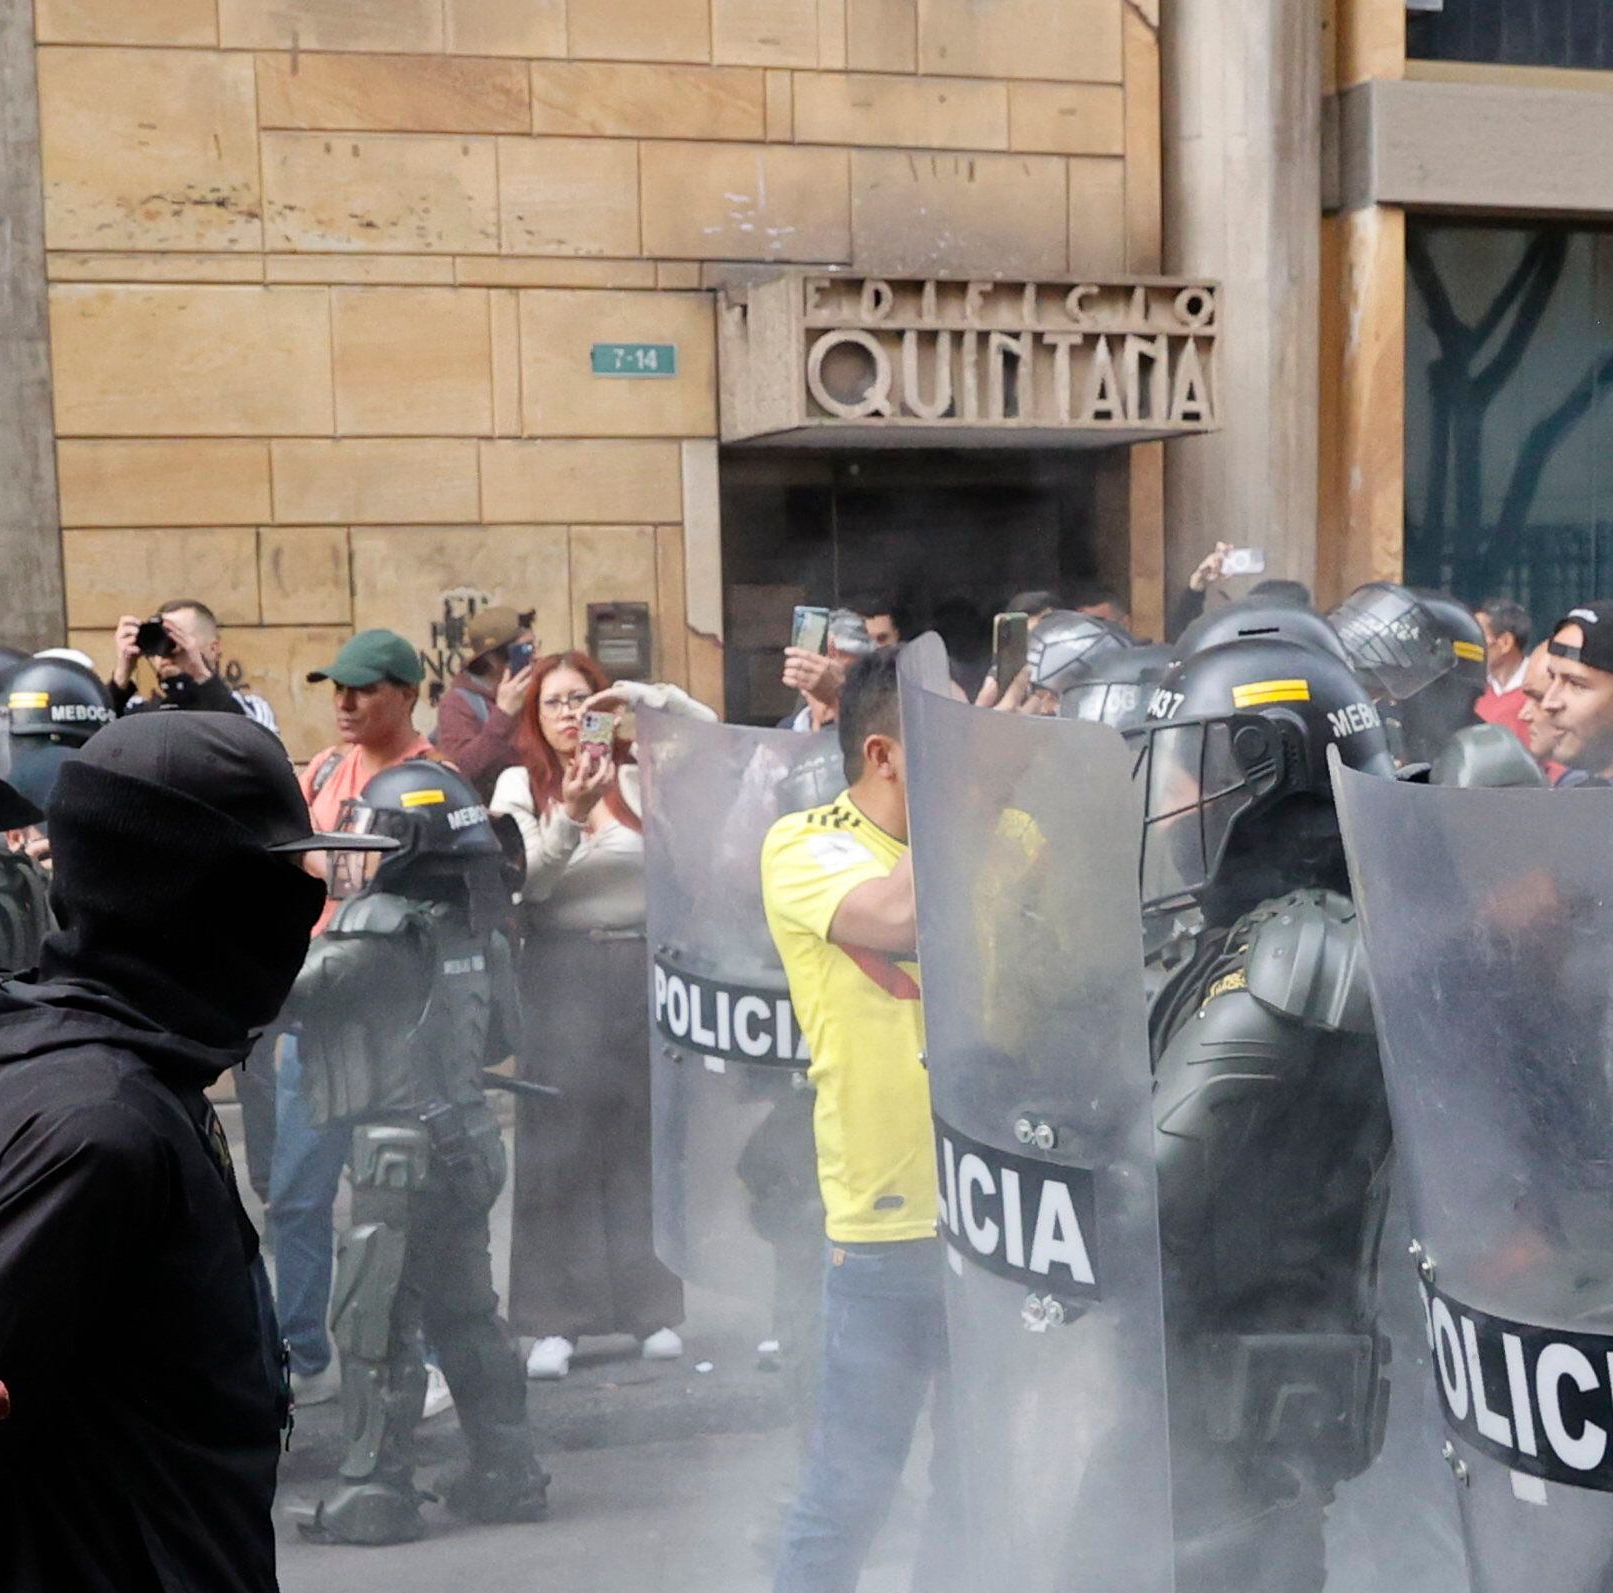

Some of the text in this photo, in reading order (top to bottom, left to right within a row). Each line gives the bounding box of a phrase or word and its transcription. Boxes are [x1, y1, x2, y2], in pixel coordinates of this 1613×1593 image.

[805, 278, 1216, 328] EDIFICIO
[612, 347, 659, 370] 7-14
[807, 329, 1216, 422] QUINTANA
[655, 964, 811, 1060] POLICI
